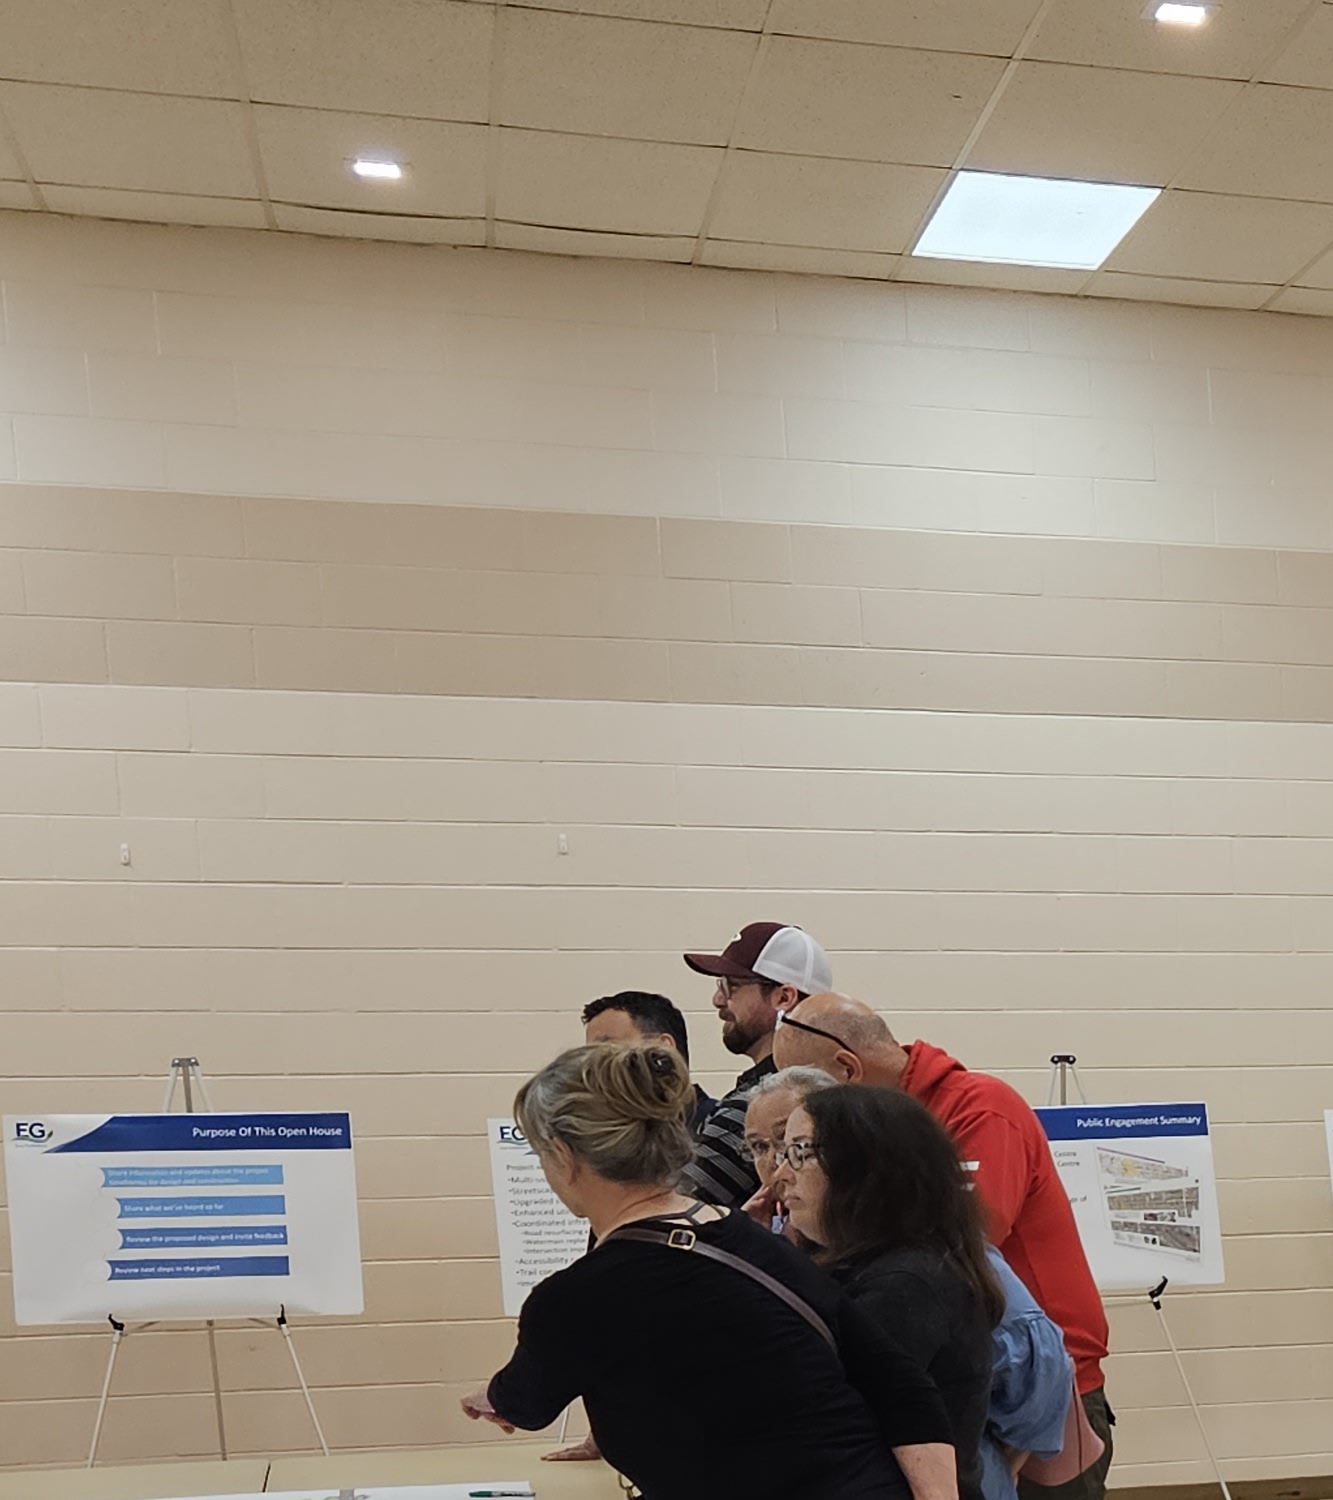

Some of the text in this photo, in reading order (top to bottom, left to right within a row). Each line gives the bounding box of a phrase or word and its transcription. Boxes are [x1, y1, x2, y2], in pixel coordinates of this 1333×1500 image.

[1076, 1114, 1202, 1129] Public Engagement Summary
[16, 1122, 46, 1139] EG
[192, 1126, 343, 1139] Purpose Of This Open House
[145, 1203, 163, 1212] what
[184, 1202, 205, 1211] heard
[515, 1219, 566, 1228] Coordinated
[126, 1235, 151, 1244] Review
[151, 1235, 164, 1243] the
[164, 1235, 197, 1244] proposed
[197, 1233, 220, 1243] design
[221, 1233, 234, 1241] and
[253, 1232, 284, 1240] feedback
[183, 1264, 196, 1273] the
[196, 1264, 221, 1274] project
